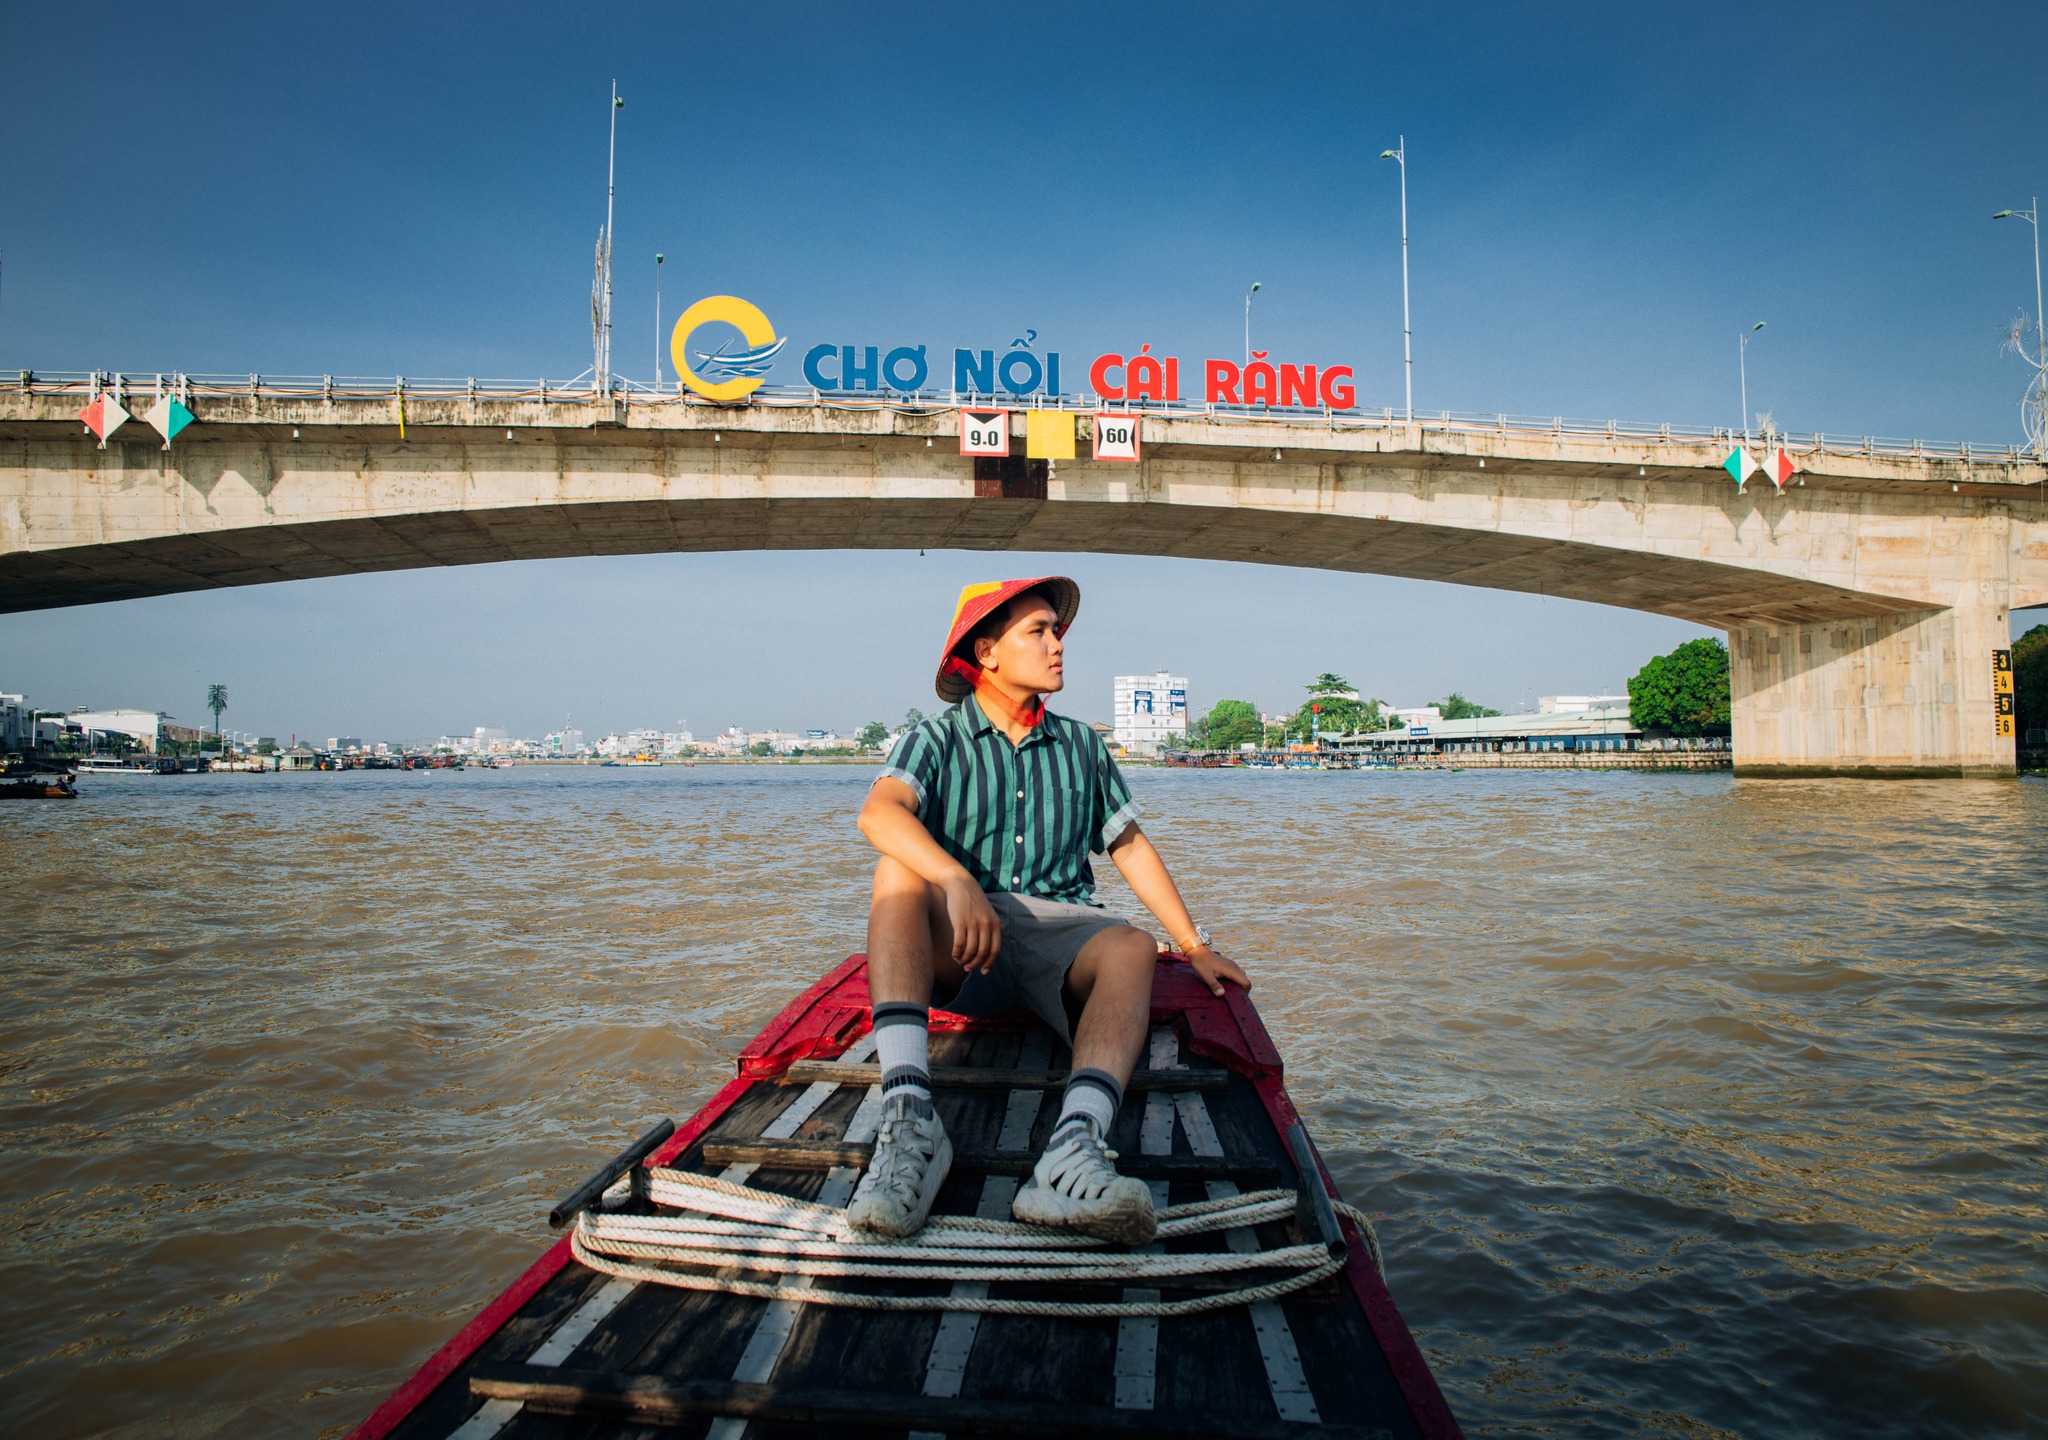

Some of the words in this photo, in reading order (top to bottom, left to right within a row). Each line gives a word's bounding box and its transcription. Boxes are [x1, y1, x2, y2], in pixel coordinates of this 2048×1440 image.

[803, 343, 929, 404] CHỢ
[954, 329, 1061, 397] NỔI
[1089, 344, 1180, 402] CÁI
[1206, 350, 1357, 411] RĂNG
[970, 430, 999, 446] 9.0
[1106, 427, 1128, 444] 60
[1999, 654, 2007, 668] 3
[2001, 676, 2007, 689] 4
[2002, 697, 2009, 711] 5
[2003, 720, 2009, 733] 6
